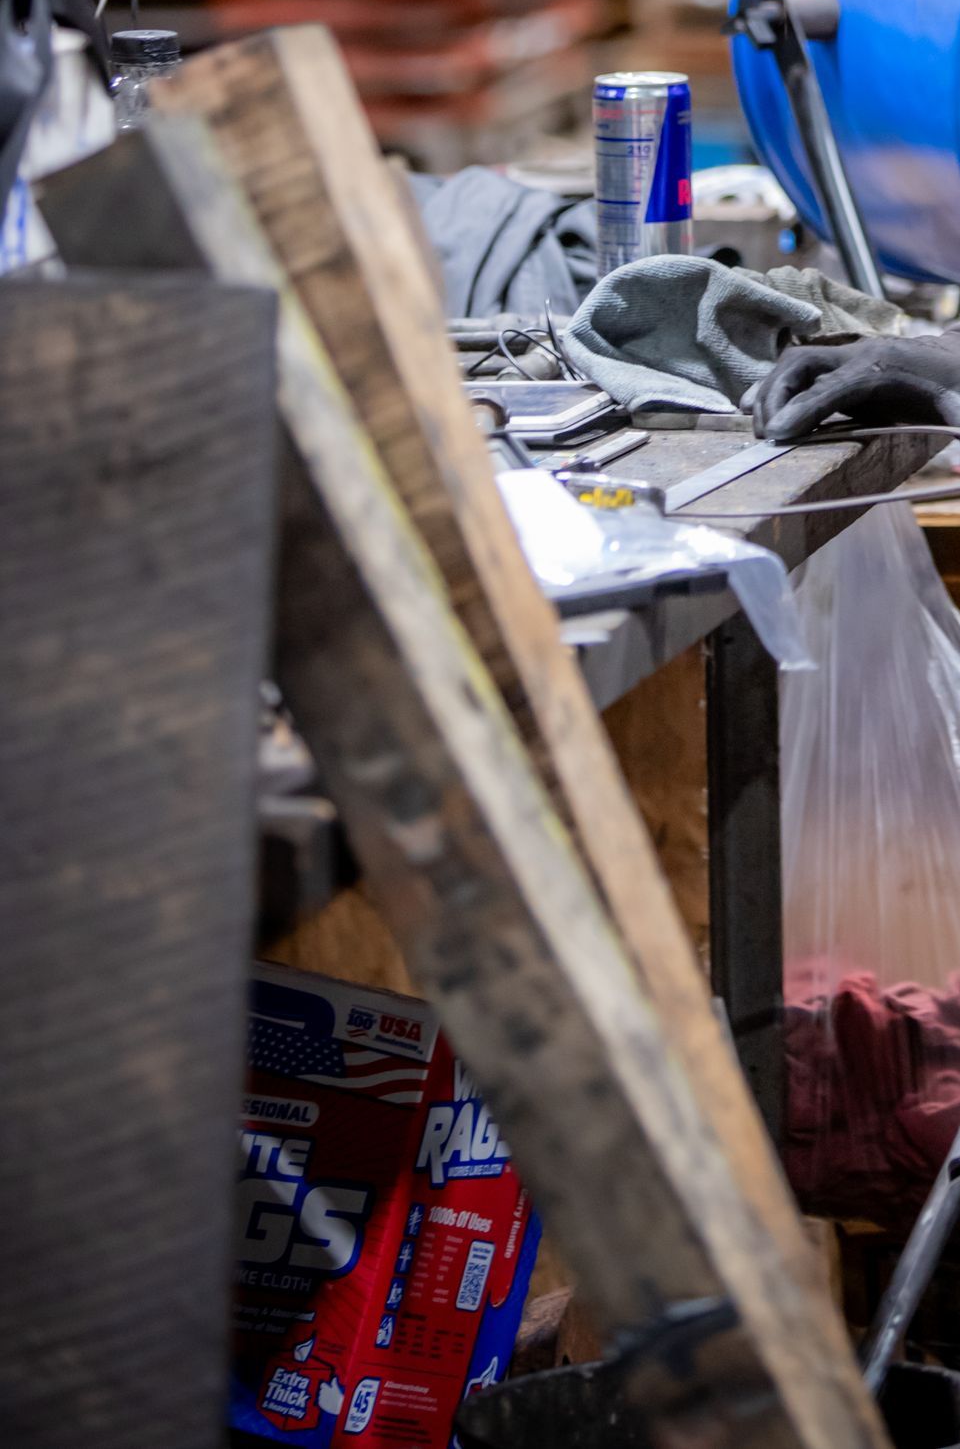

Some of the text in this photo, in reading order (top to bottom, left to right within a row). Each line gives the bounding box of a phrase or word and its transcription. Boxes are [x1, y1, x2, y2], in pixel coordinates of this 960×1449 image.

[379, 1015, 421, 1042] USA
[239, 1129, 312, 1177] ITE
[236, 1177, 368, 1271] GS
[260, 1271, 313, 1292] CLOTH
[272, 1367, 310, 1389] Extra
[265, 1381, 311, 1408] Thick
